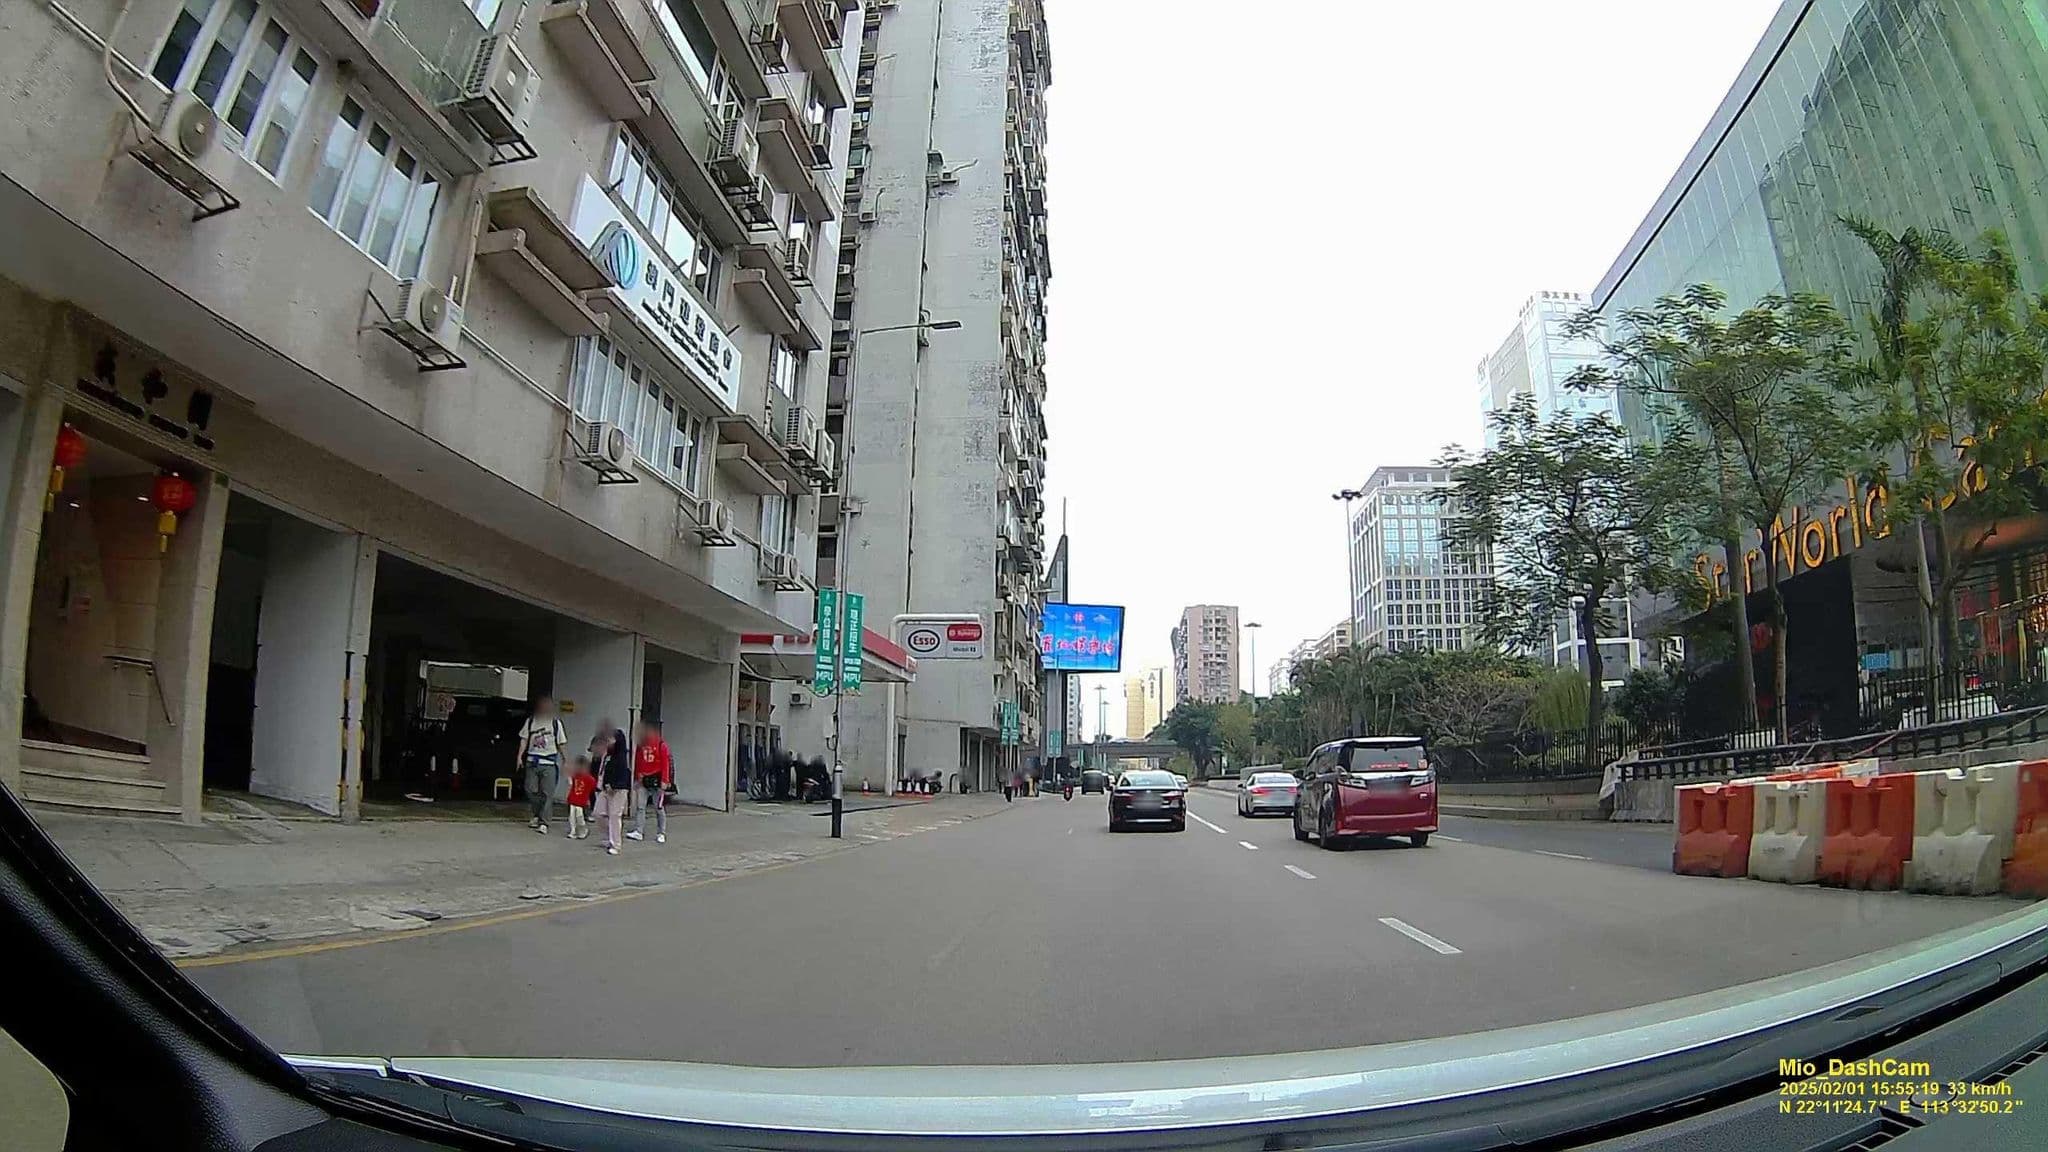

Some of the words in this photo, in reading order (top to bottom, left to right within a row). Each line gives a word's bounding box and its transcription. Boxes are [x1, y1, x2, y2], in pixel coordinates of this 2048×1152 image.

[913, 635, 936, 646] Esso
[816, 670, 834, 681] MPU
[843, 672, 861, 683] MPU
